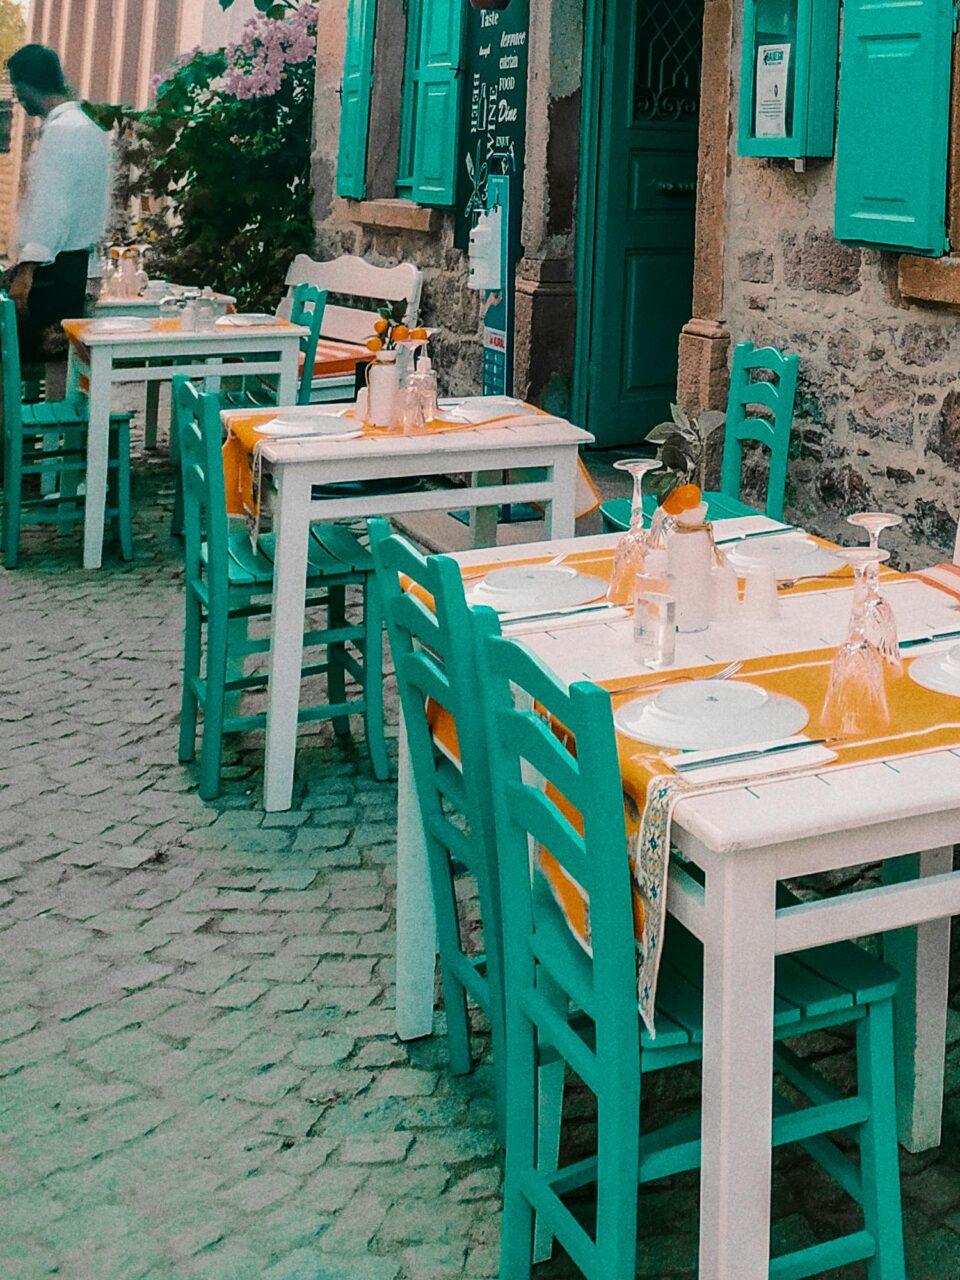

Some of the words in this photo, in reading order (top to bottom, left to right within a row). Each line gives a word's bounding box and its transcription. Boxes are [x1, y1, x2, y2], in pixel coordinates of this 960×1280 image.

[480, 9, 499, 28] Taste
[499, 77, 515, 91] FOOD
[470, 73, 480, 133] BEER
[498, 99, 517, 122] Dine
[486, 85, 498, 160] WINE
